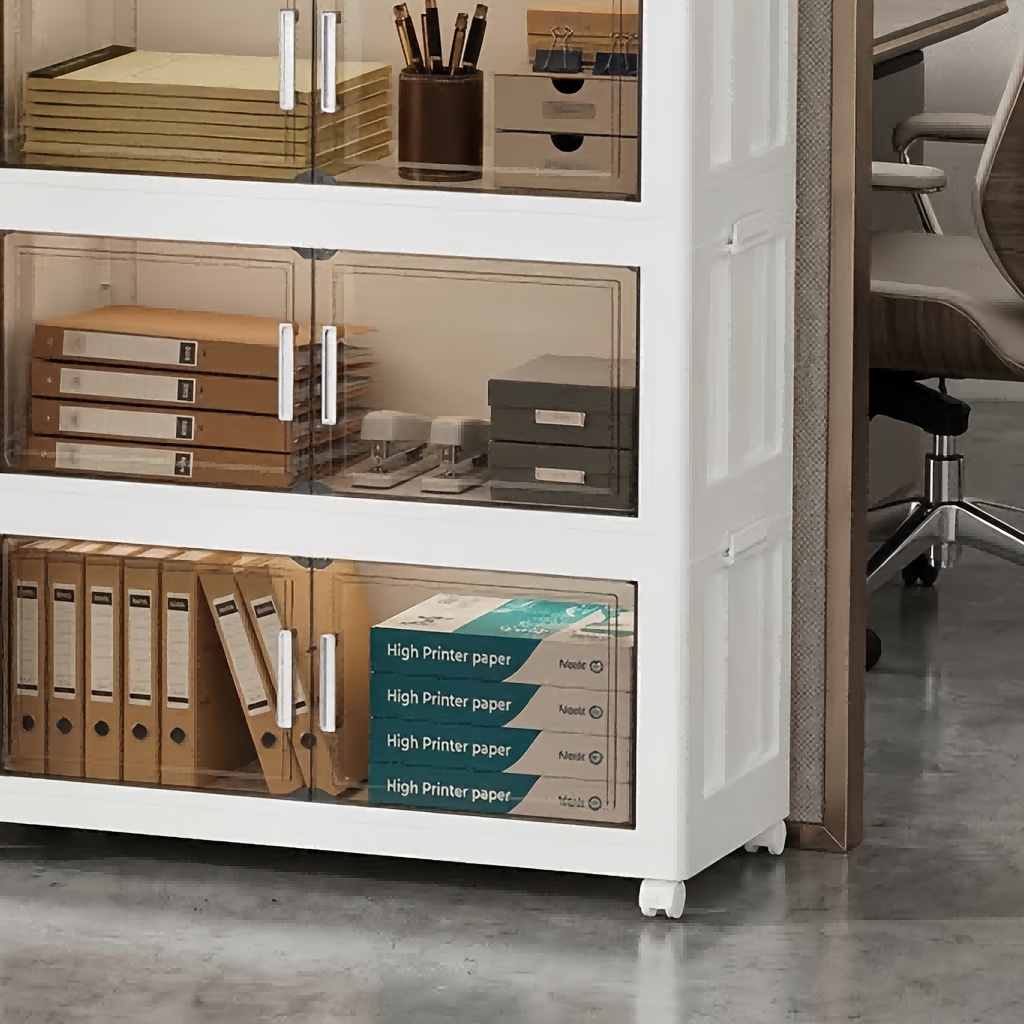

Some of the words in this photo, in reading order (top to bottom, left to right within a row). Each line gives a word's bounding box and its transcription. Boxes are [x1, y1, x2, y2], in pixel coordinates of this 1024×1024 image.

[387, 643, 419, 661] High
[422, 646, 468, 663] Printer
[472, 653, 512, 667] paper
[387, 688, 419, 706] High
[422, 691, 468, 708] Printer
[472, 698, 512, 713] paper
[387, 734, 419, 751] High
[422, 736, 468, 753] Printer
[472, 742, 512, 758] paper
[387, 778, 419, 796] High
[422, 781, 468, 798] Printer
[472, 788, 512, 803] paper
